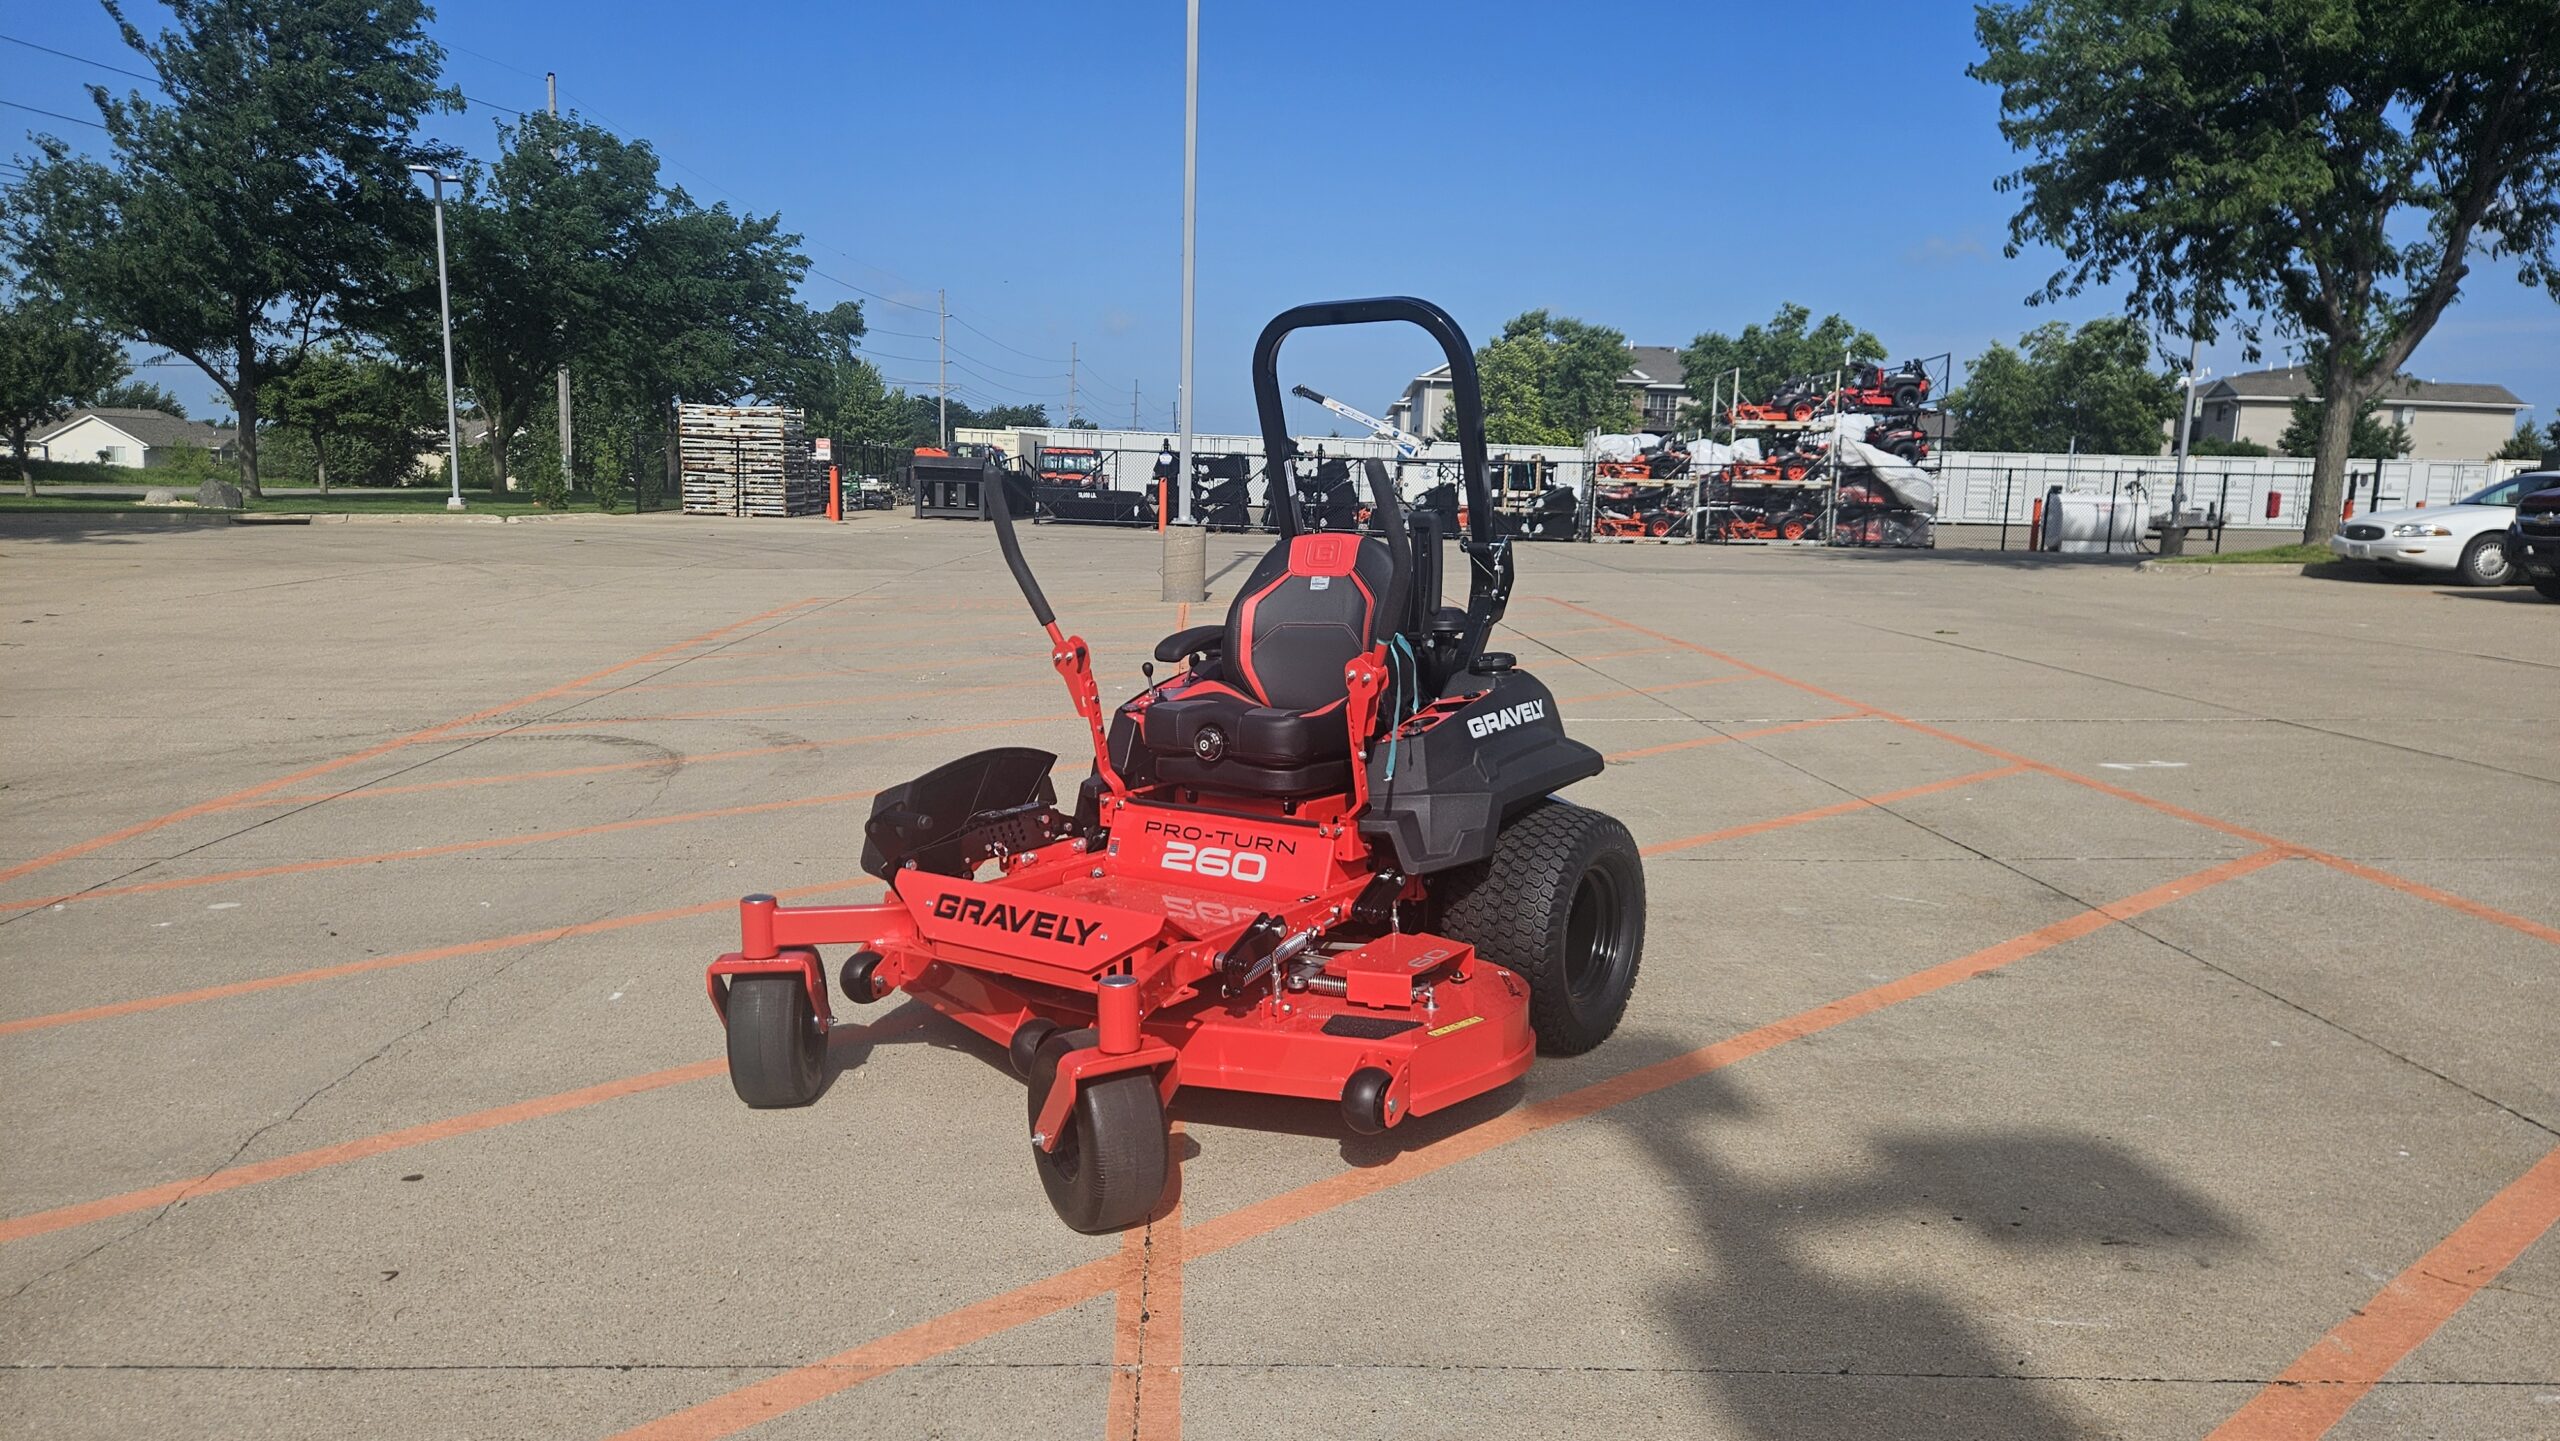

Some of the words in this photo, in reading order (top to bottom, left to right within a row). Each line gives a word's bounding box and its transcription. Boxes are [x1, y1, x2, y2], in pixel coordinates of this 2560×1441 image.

[1466, 698, 1545, 739] GRAVELY
[1144, 820, 1297, 855] PRO-TURN
[1160, 840, 1268, 883] 260
[933, 892, 1103, 946] GRAVELY
[1407, 949, 1449, 968] 60
